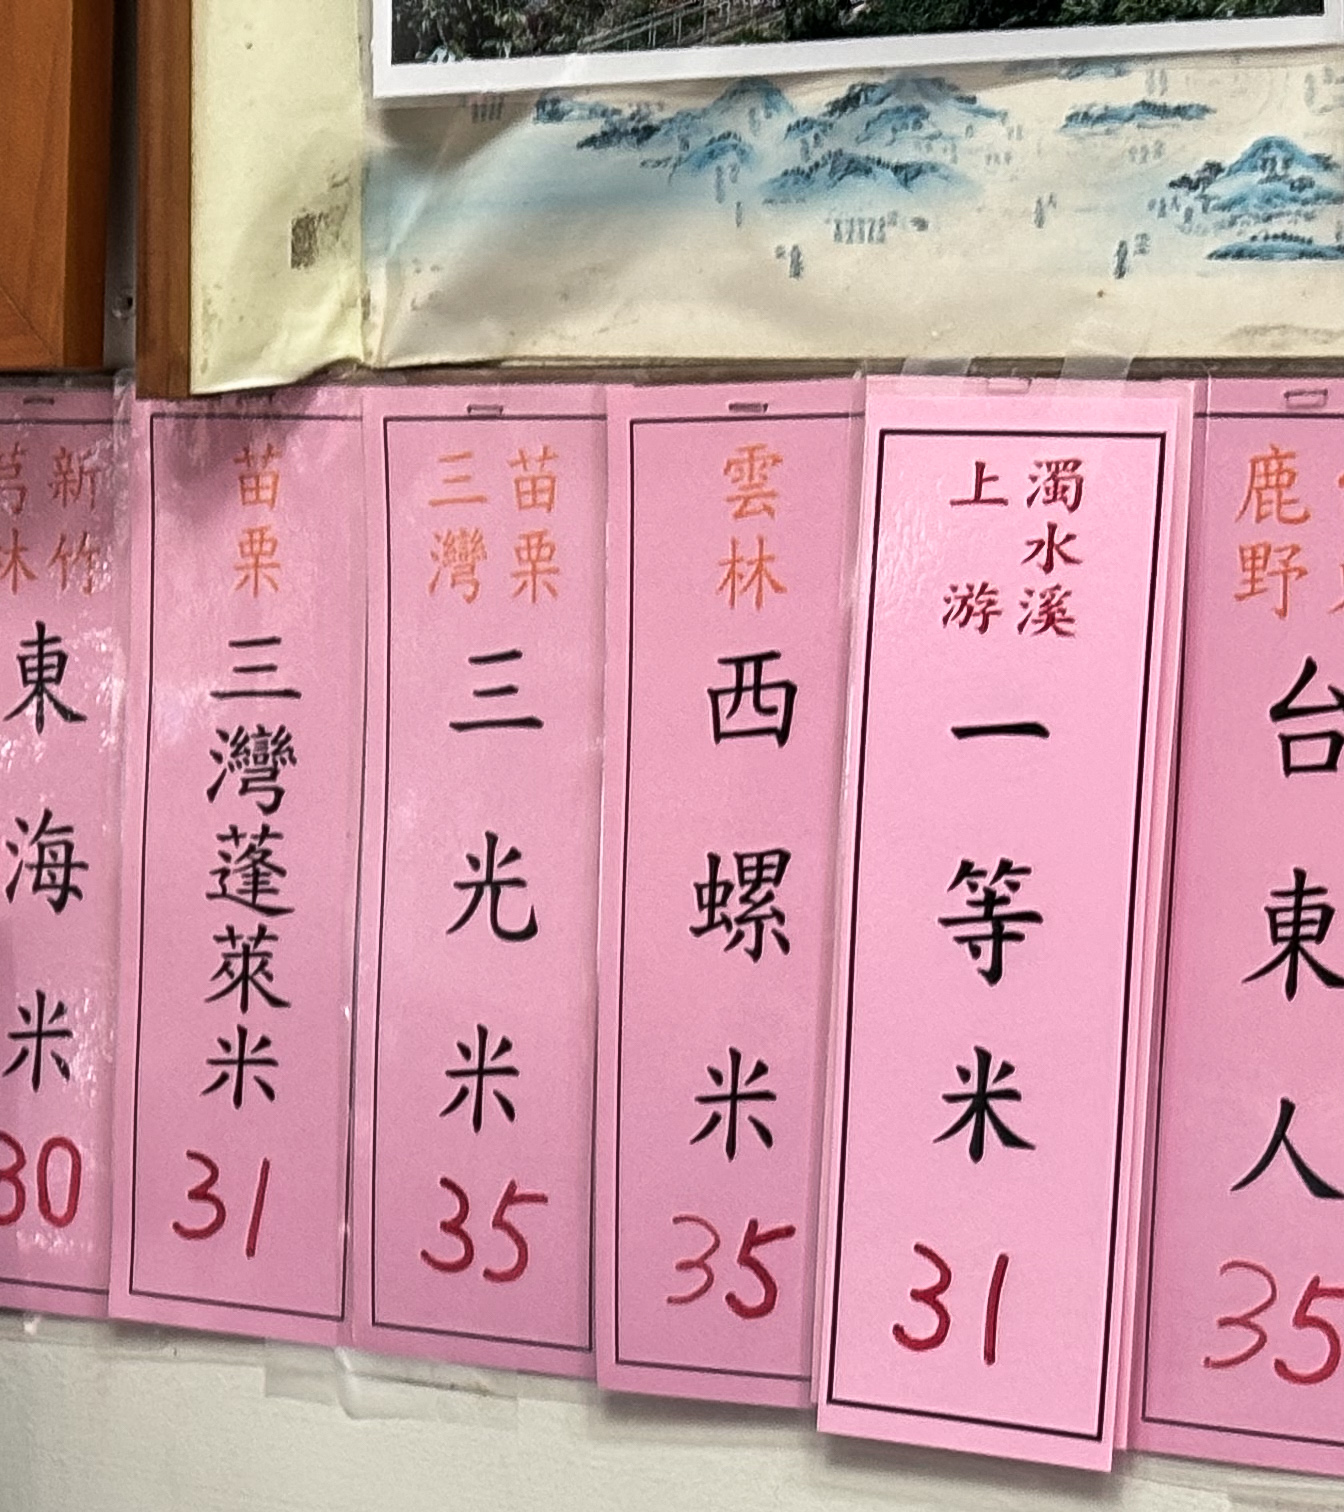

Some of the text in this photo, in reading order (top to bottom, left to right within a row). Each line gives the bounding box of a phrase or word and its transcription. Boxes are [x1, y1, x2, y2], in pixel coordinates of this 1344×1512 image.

[47, 445, 98, 597] 新竹
[233, 444, 281, 598] 苗栗
[427, 450, 489, 604] 三灣
[507, 445, 561, 604] 苗栗
[717, 442, 787, 611] 雲林
[942, 459, 1010, 636] 上游
[1016, 458, 1085, 637] 濁水溪
[1232, 443, 1312, 620] 鹿野
[1, 619, 90, 1094] 東海米
[199, 635, 302, 1110] 三灣蓬萊米
[439, 648, 545, 1134] 三光米
[688, 648, 799, 1163] 西螺米
[932, 719, 1051, 1165] 一等米
[172, 1149, 271, 1259] 31
[419, 1176, 550, 1283] 35
[666, 1214, 797, 1320] 35
[892, 1242, 1010, 1367] 31
[1202, 1259, 1344, 1386] 35
